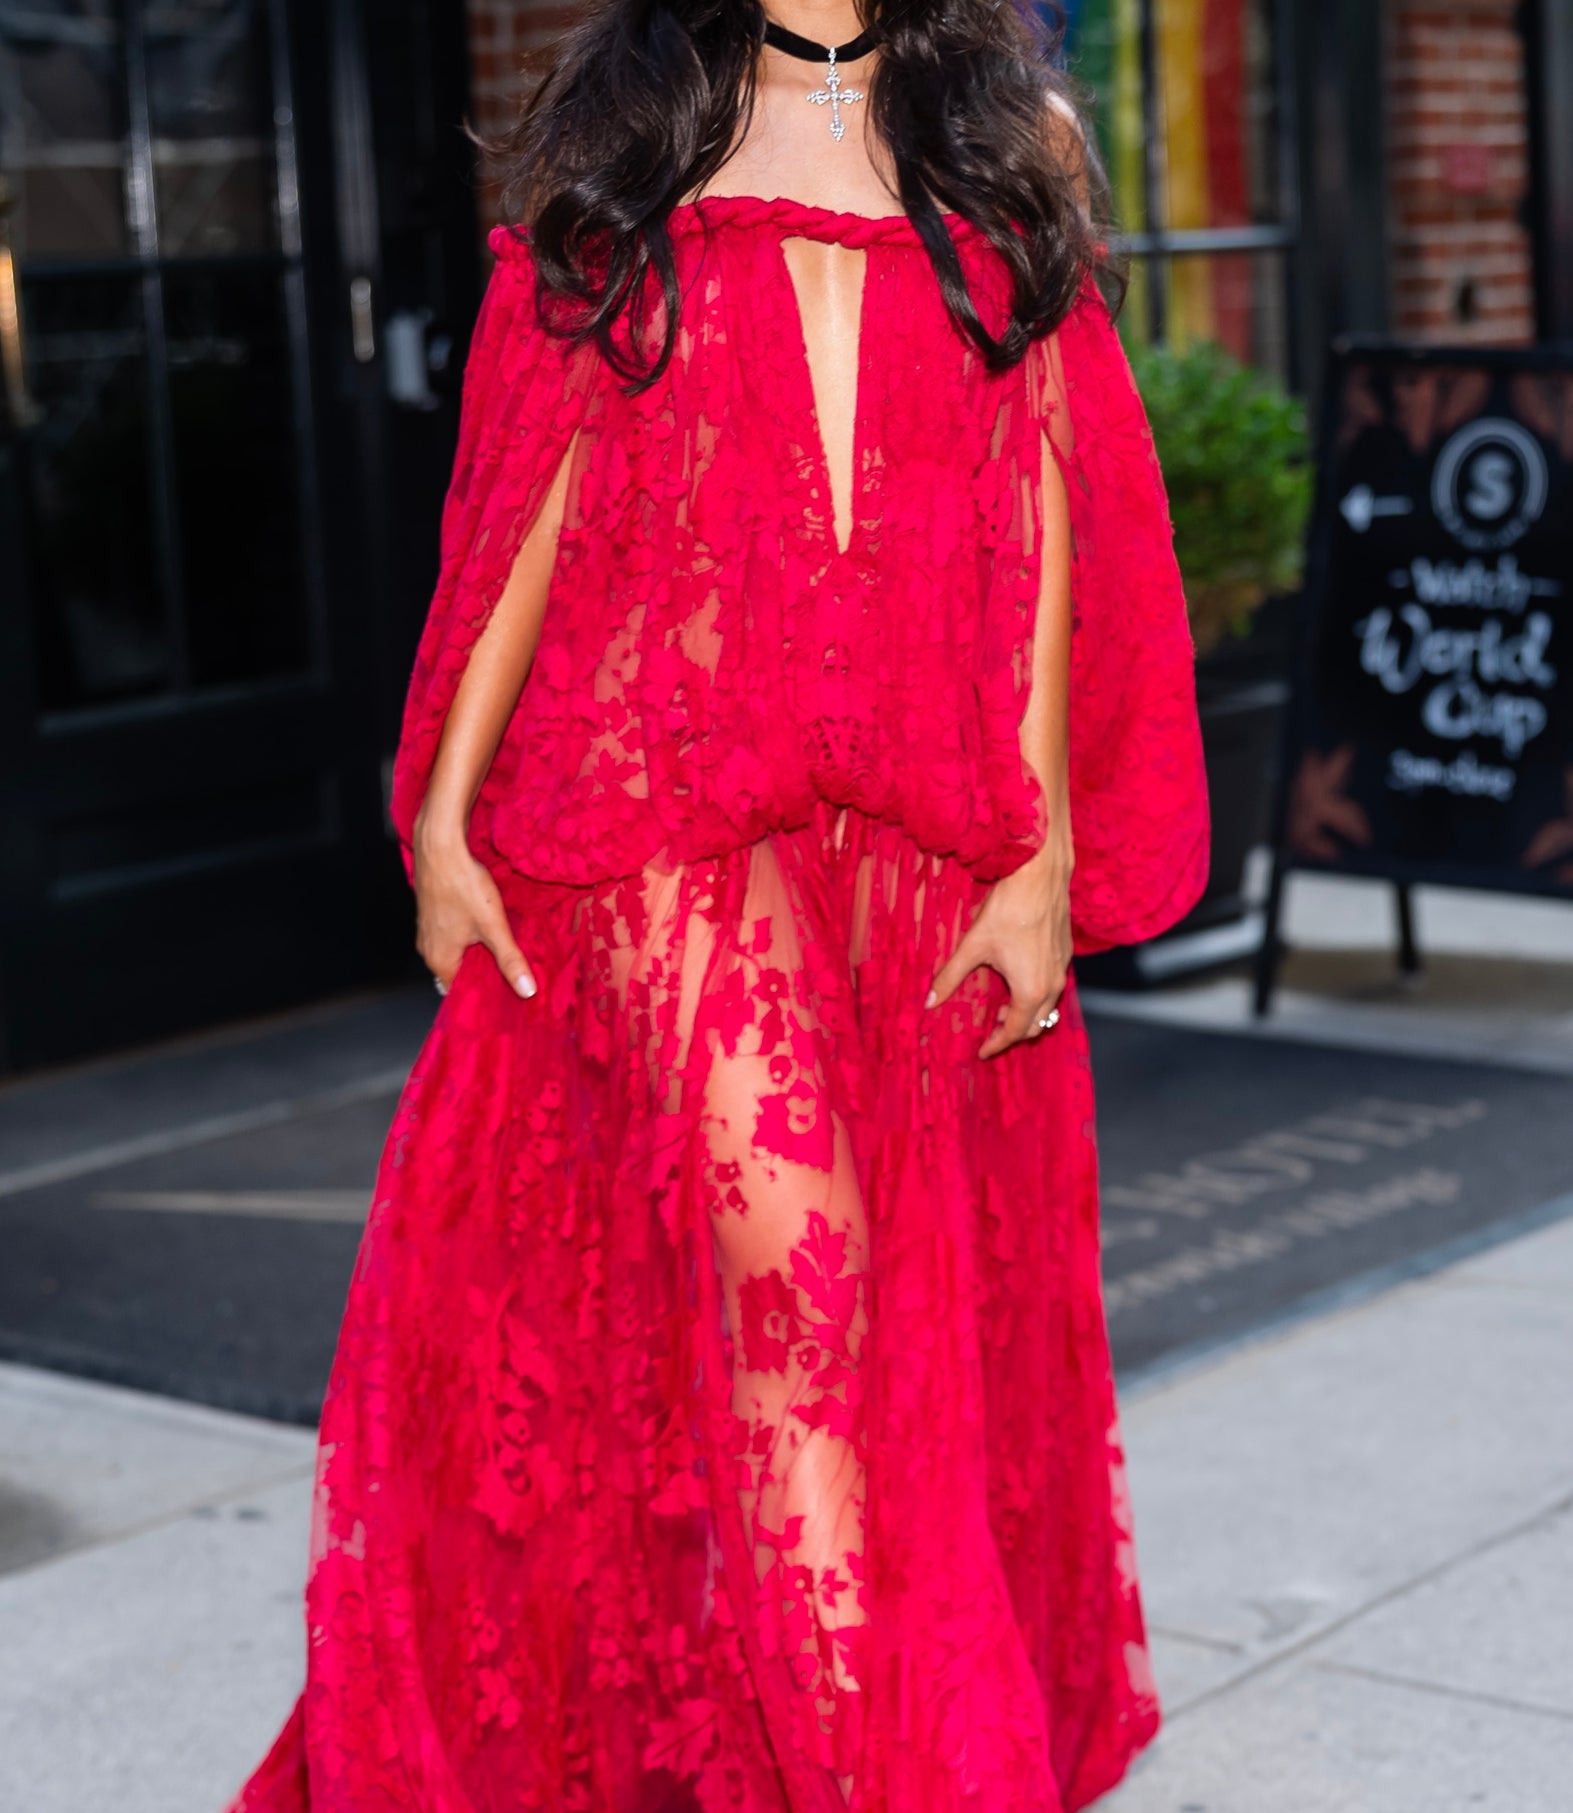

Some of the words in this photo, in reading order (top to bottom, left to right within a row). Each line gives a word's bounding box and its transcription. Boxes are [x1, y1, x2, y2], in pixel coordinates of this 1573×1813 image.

[1465, 451, 1516, 520] S
[1355, 602, 1557, 695] World
[1422, 677, 1547, 758] Cup
